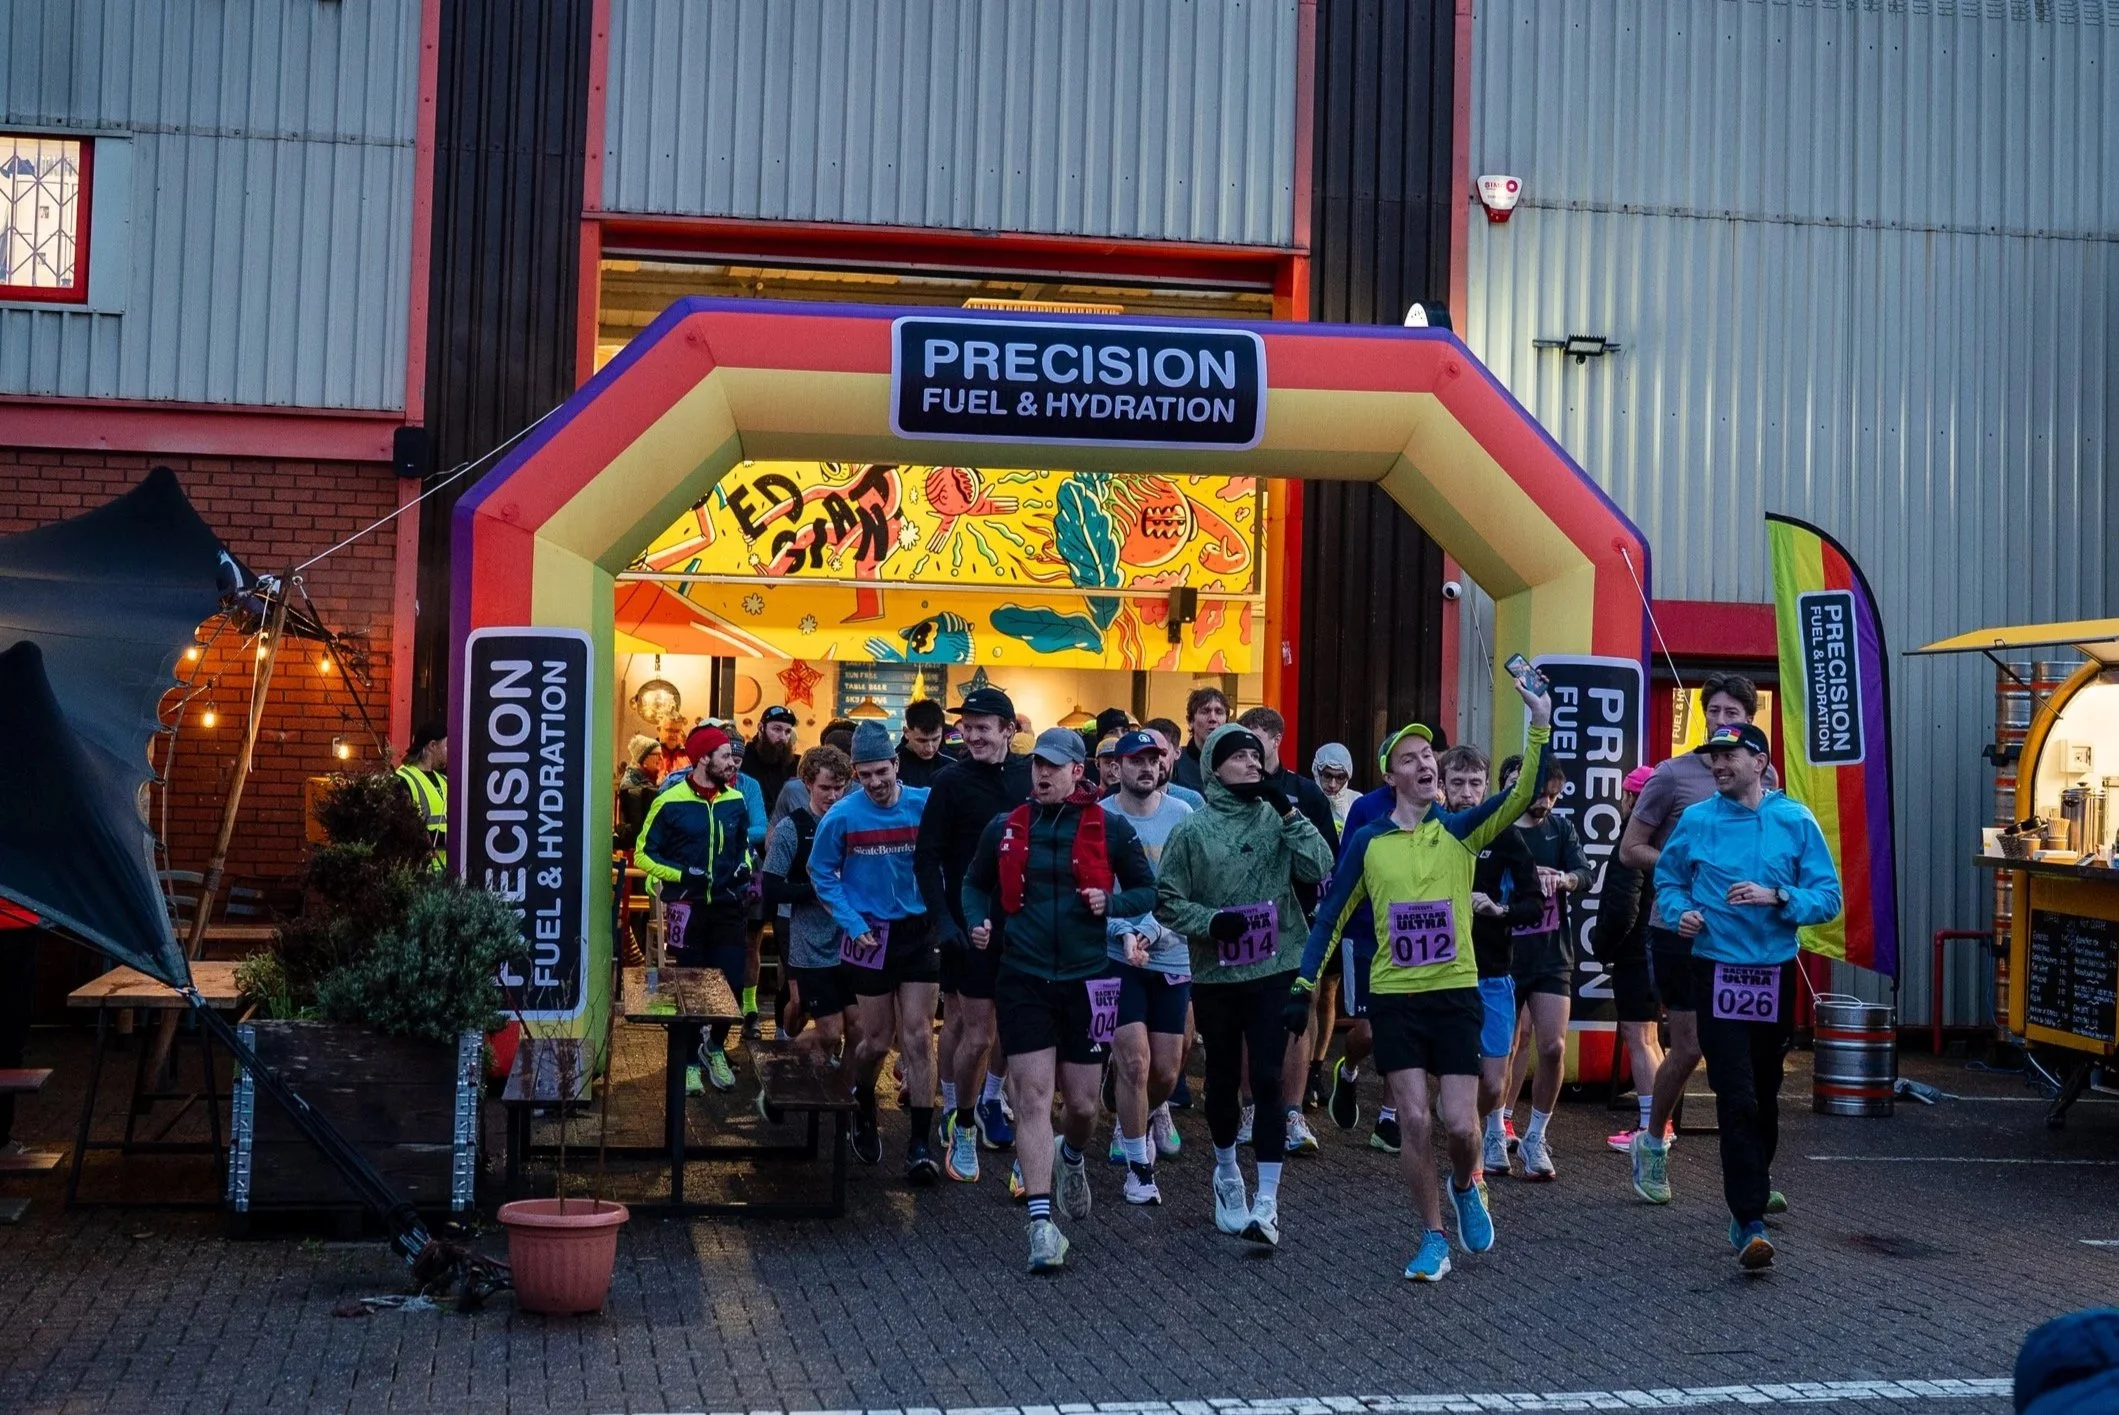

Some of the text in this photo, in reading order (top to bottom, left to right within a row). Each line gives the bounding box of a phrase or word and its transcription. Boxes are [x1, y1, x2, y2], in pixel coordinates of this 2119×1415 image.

[924, 338, 1237, 390] PRECISION
[922, 388, 1235, 423] FUEL & HYDRATION
[1810, 606, 1830, 752] FUEL & HYDRATION
[1825, 604, 1851, 752] PRECISION
[1675, 702, 1684, 710] &
[1673, 712, 1683, 738] FUEL
[484, 659, 533, 987] ECISION
[534, 660, 568, 987] FUEL & HYDRATION
[1396, 918, 1448, 931] ULTRA
[843, 936, 882, 963] 007
[1223, 931, 1274, 961] 014
[1396, 933, 1452, 961] 012
[1722, 974, 1772, 986] ULTRA
[1717, 988, 1773, 1017] 026
[1094, 1011, 1116, 1038] 04
